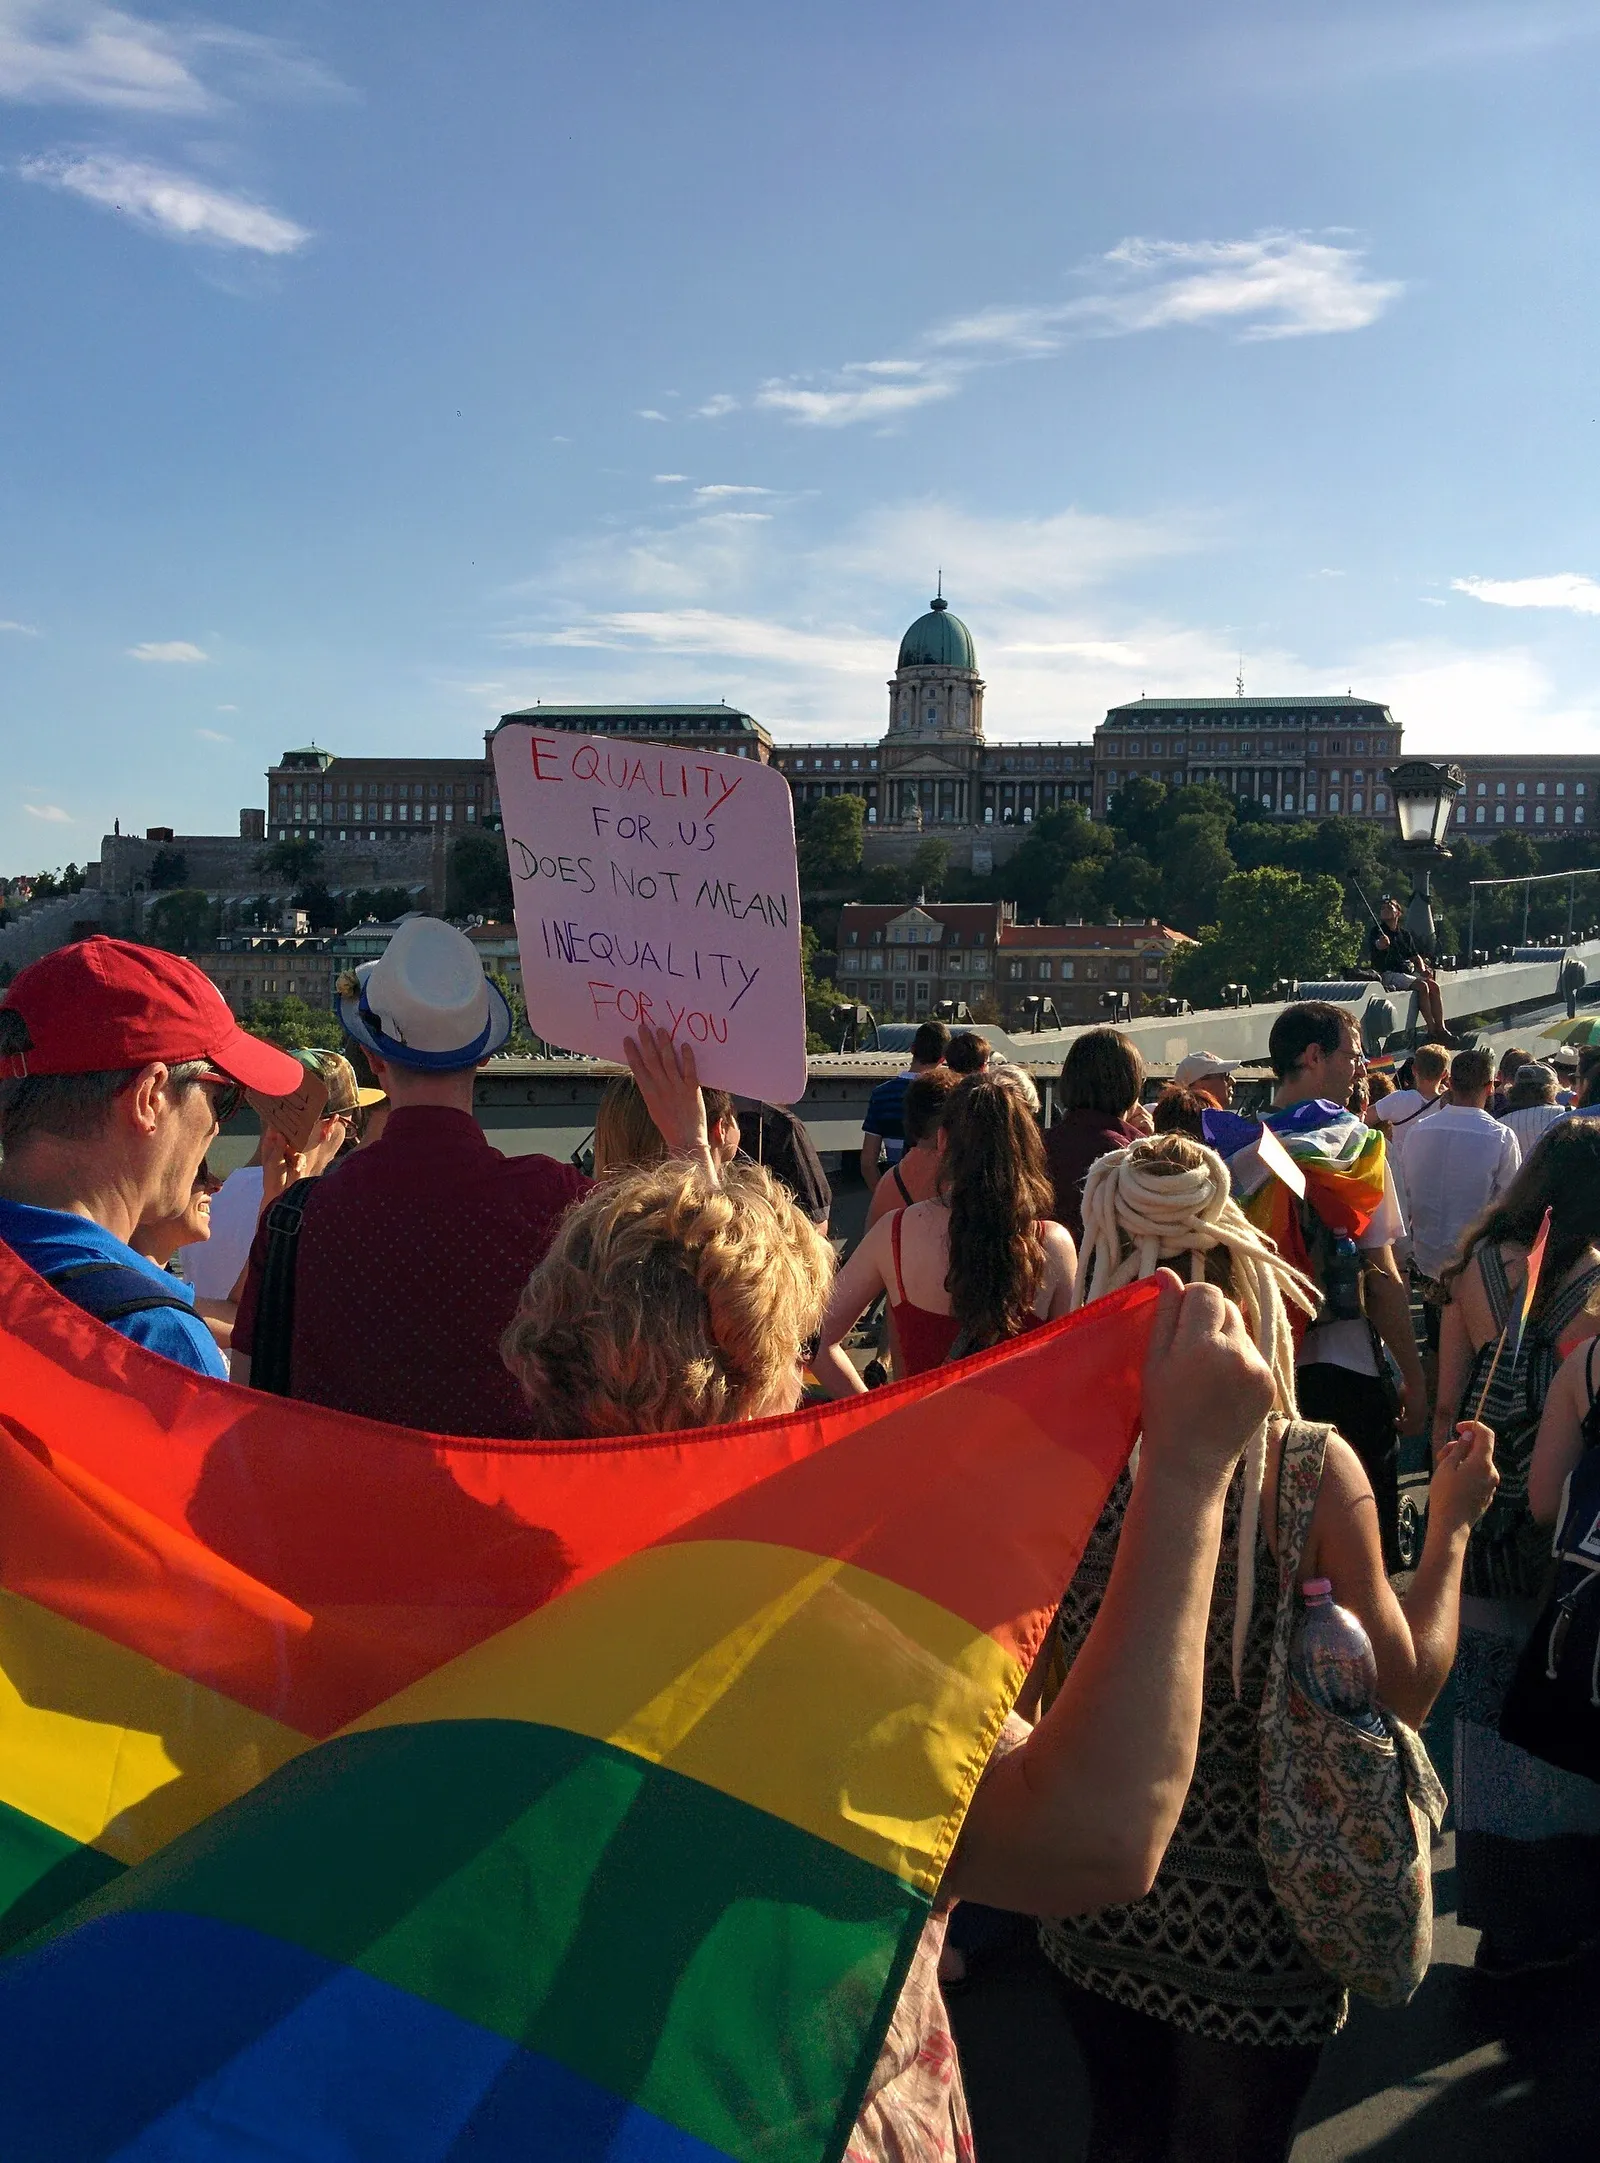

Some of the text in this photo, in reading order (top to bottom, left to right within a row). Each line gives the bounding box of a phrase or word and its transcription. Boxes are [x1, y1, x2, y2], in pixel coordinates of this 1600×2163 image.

[531, 736, 743, 820] EQUALITY
[592, 806, 716, 851] FOR US
[511, 838, 788, 928] DOES NOT MEAN
[541, 918, 760, 1011] INEQUALITY
[588, 981, 728, 1044] FOR YOU
